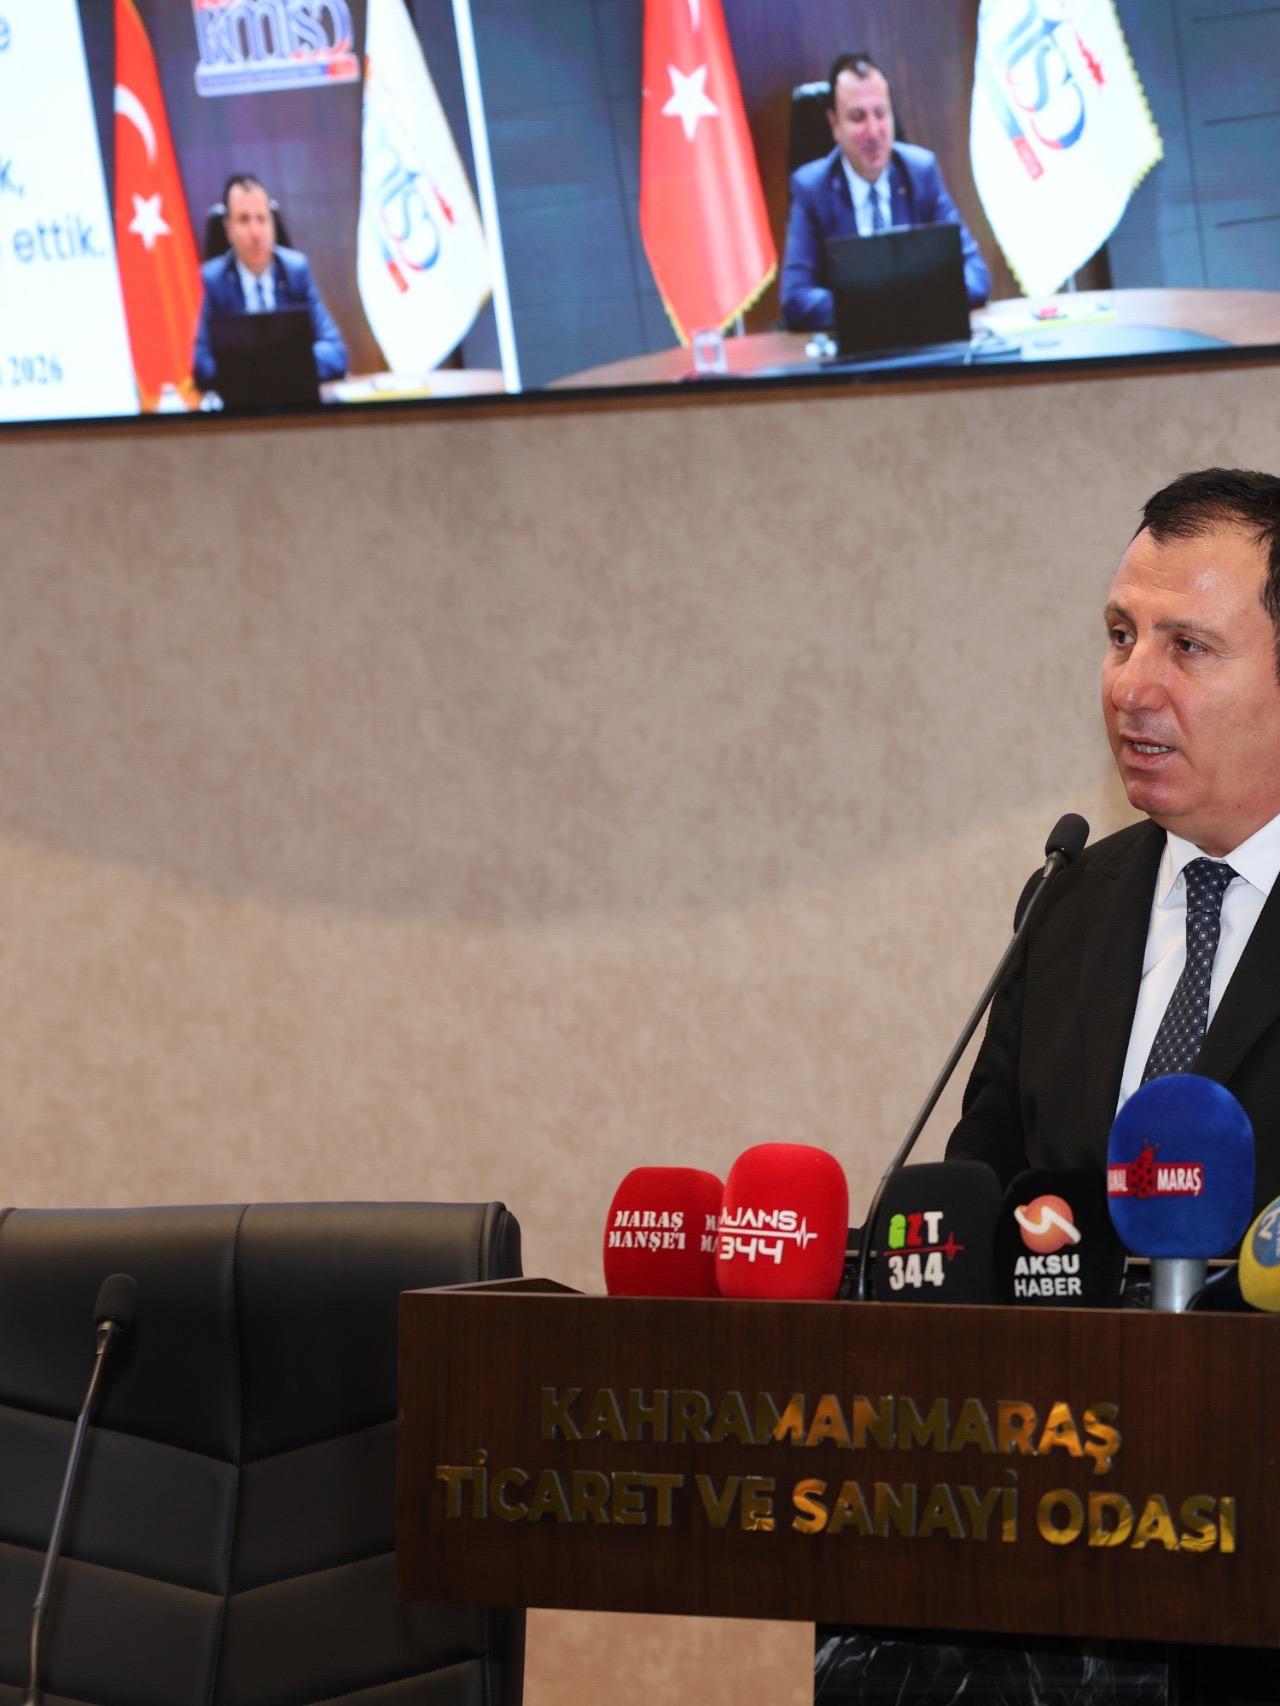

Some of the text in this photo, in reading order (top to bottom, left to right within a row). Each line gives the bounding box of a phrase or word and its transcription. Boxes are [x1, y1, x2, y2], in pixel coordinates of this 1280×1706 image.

[13, 212, 106, 263] ettik.
[1157, 1167, 1202, 1197] MARAŞ
[614, 1210, 684, 1232] MARAŞ
[608, 1230, 686, 1253] MANŞET
[719, 1235, 784, 1265] 344
[888, 1251, 945, 1291] 344
[1014, 1253, 1080, 1276] AKSU
[1014, 1276, 1082, 1298] HABER
[541, 1387, 1121, 1474] KAHRAMANMARAŞ
[436, 1448, 1237, 1554] TİCARET VE SANAYİ ODASI
